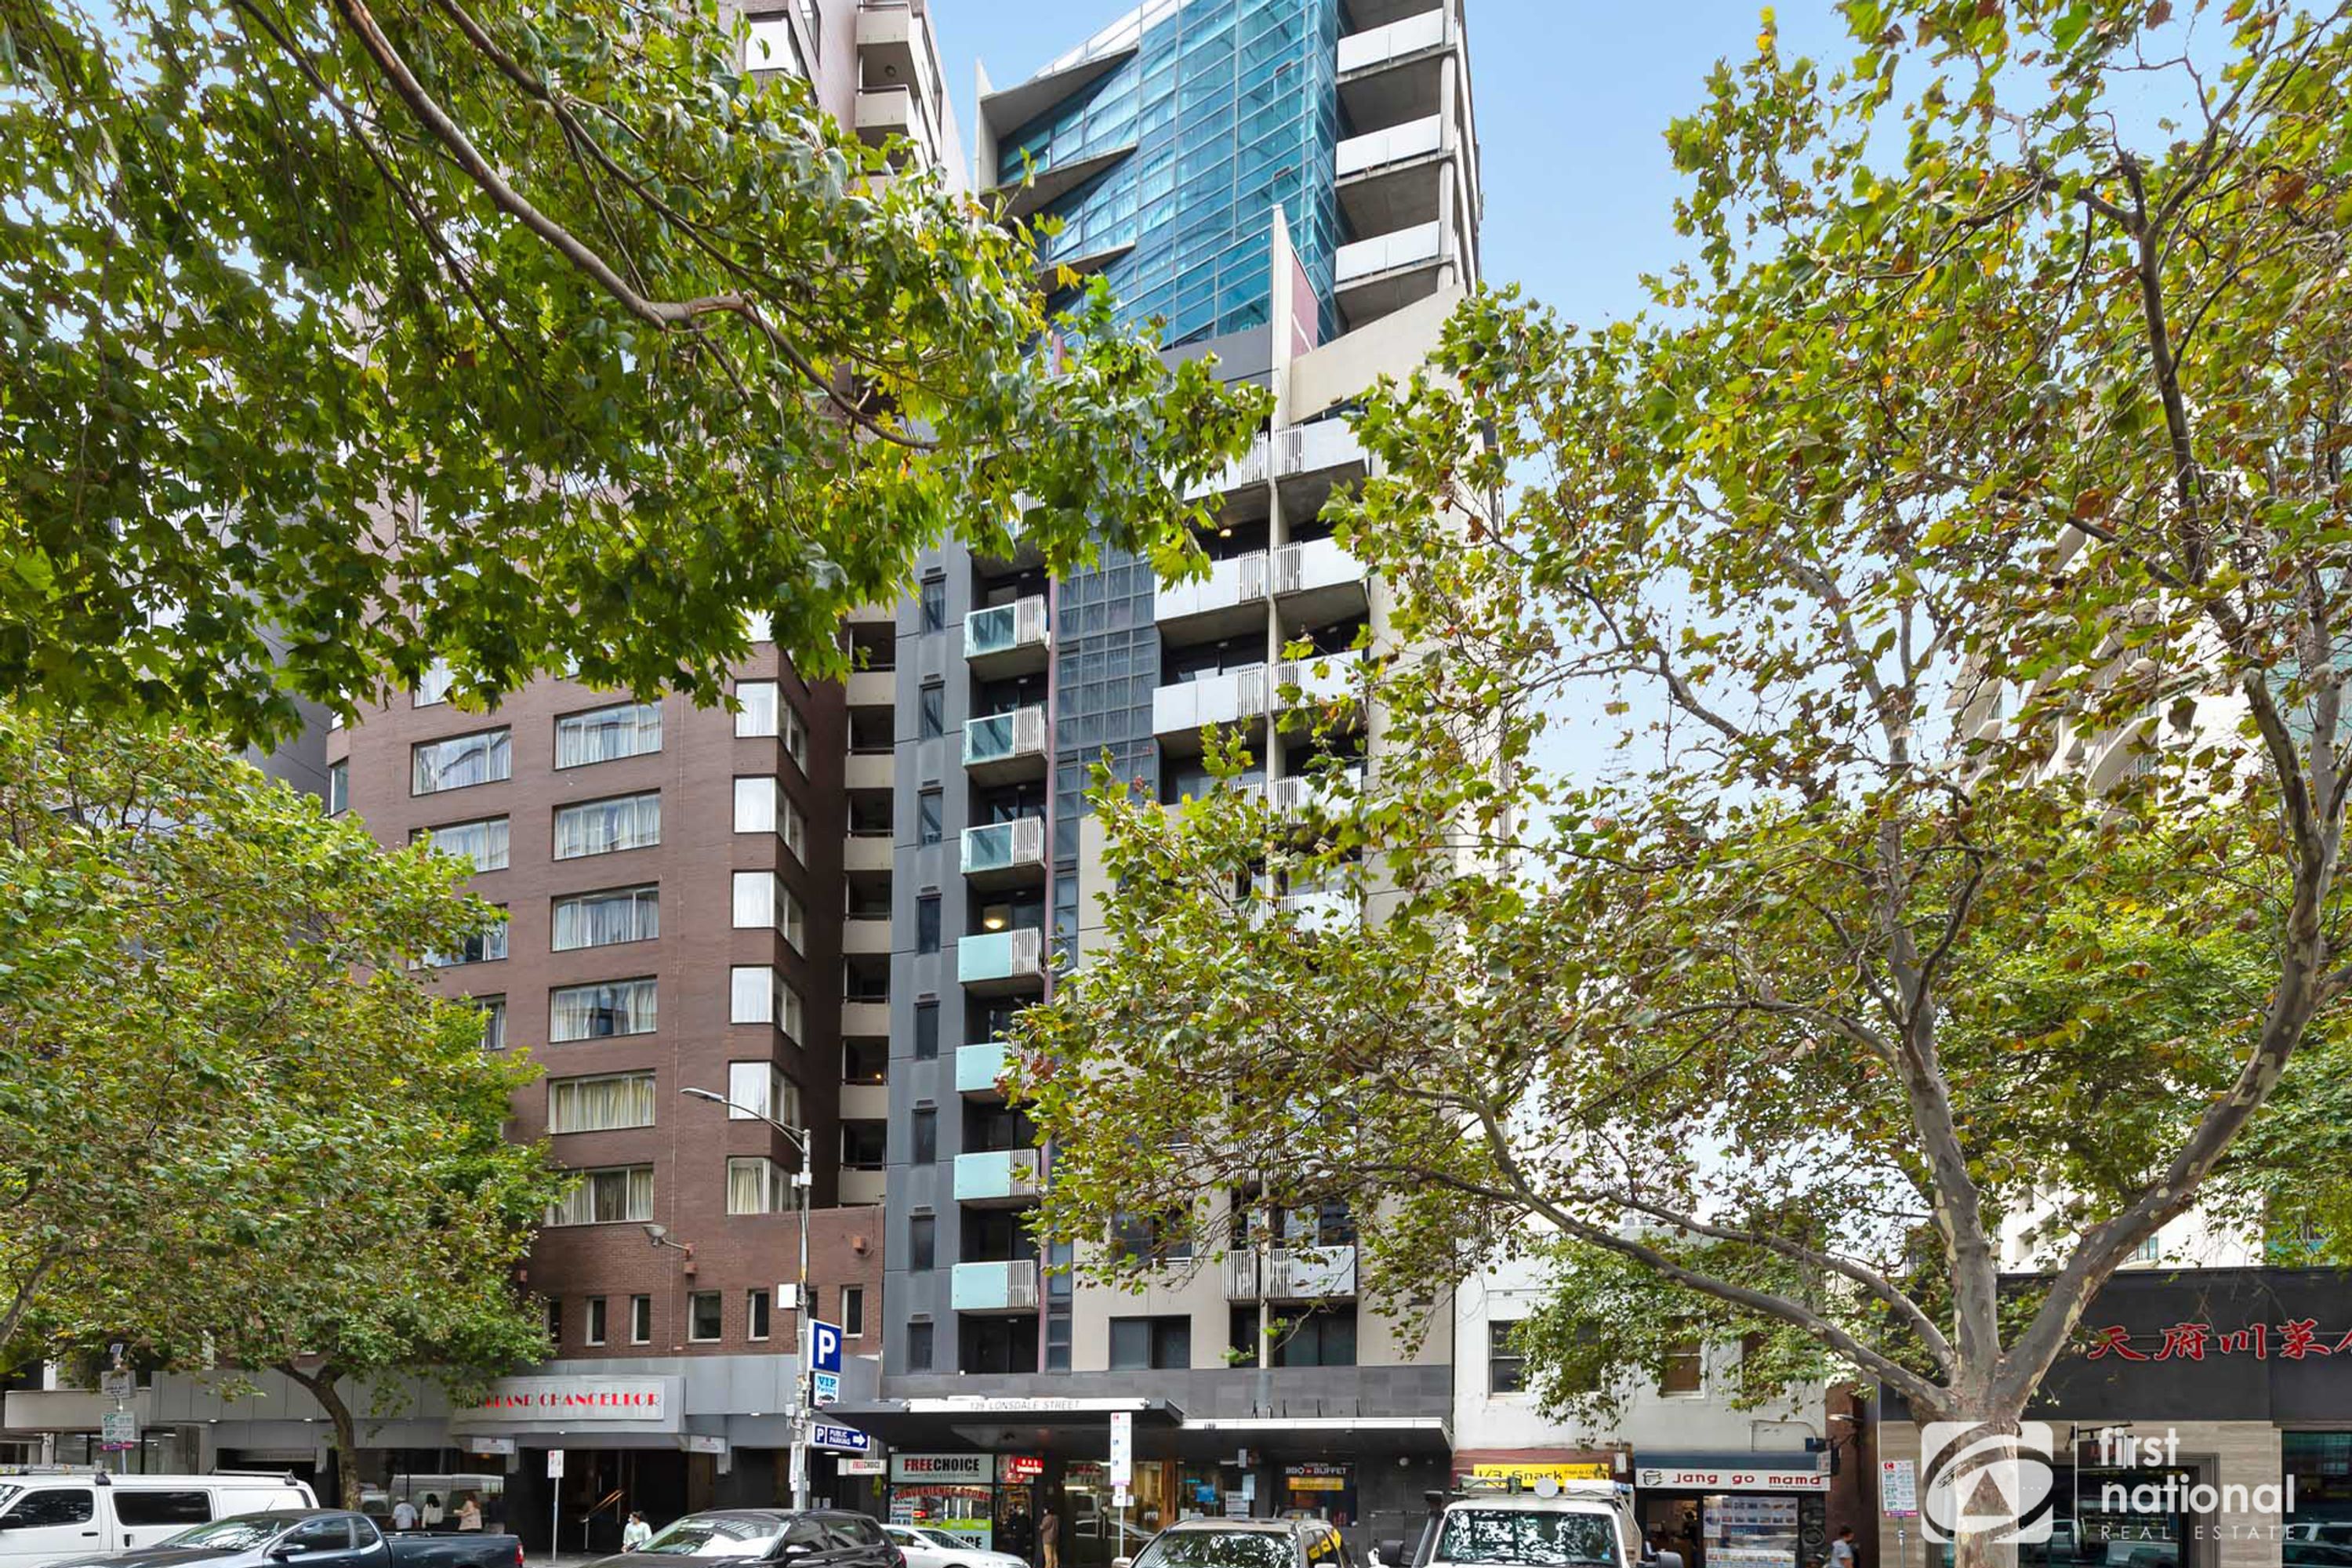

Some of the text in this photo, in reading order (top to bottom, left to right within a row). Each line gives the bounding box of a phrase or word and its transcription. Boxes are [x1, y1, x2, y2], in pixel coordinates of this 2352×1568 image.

[2087, 1318, 2352, 1361] 天府川菜
[818, 1328, 837, 1365] P
[817, 1376, 837, 1387] VIP
[539, 1393, 660, 1407] CHANCELLOR
[989, 1401, 1037, 1410] LONSDALE
[1043, 1399, 1080, 1410] STREET
[816, 1428, 848, 1441] P PUBLIC
[829, 1436, 851, 1446] PARKING
[903, 1457, 979, 1472] FREECHOICE
[1732, 1474, 1755, 1485] go
[1769, 1475, 1821, 1486] mama
